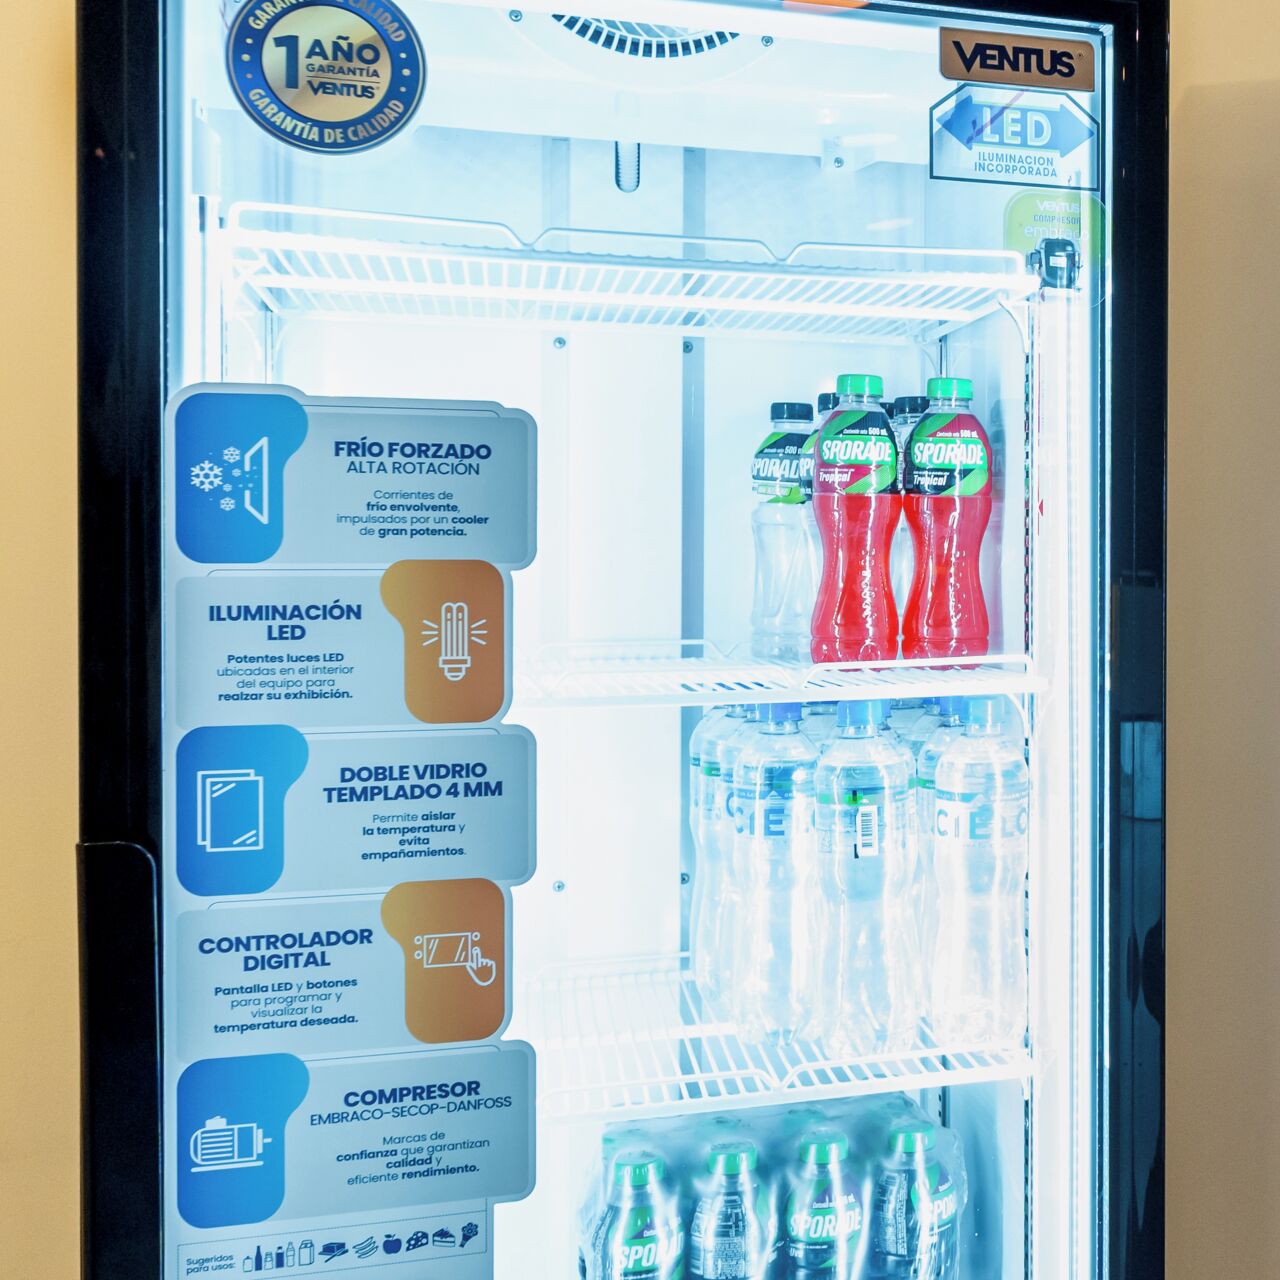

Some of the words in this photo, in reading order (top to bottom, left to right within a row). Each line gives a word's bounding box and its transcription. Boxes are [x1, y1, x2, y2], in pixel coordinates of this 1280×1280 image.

[273, 35, 299, 89] 1
[305, 35, 380, 65] AÑO
[952, 40, 1075, 78] VENTUS
[306, 63, 380, 78] GARANTÍA
[307, 80, 375, 99] VENTUS
[248, 88, 319, 142] GARANTÍA
[324, 128, 345, 143] DE
[347, 100, 404, 141] CALIDAD
[982, 106, 1051, 146] LED
[978, 151, 1054, 166] ILUMINACION
[974, 162, 1057, 177] INCORPORADA
[334, 436, 384, 457] FRÍO
[388, 441, 492, 460] FORZADO
[822, 440, 892, 461] SPORADE
[914, 442, 984, 465] SPORADE
[346, 460, 388, 474] ALTA
[392, 458, 480, 475] ROTACIÓN
[373, 489, 435, 500] Corrientes
[438, 490, 453, 500] de
[366, 501, 388, 512] frío
[390, 502, 461, 514] envolvente,
[336, 513, 408, 527] impulsados
[410, 515, 431, 527] por
[433, 516, 449, 525] un
[451, 514, 489, 525] cooler
[359, 525, 375, 536] de
[378, 527, 407, 539] gran
[410, 525, 467, 539] potencia.
[208, 599, 362, 621] ILUMINACIÓN
[266, 624, 306, 641] LED
[227, 653, 284, 665] Potentes
[286, 653, 320, 663] luces
[323, 652, 344, 663] LED
[217, 665, 276, 677] ubicadas
[279, 667, 295, 676] en
[298, 665, 310, 675] el
[312, 664, 354, 675] interior
[236, 677, 257, 688] del
[259, 677, 303, 691] equipo
[305, 678, 335, 691] para
[266, 691, 282, 701] su
[284, 689, 353, 700] exhibición.
[340, 766, 410, 784] DOBLE
[413, 762, 488, 781] VIDRIO
[323, 782, 442, 803] TEMPLADO
[446, 782, 461, 798] 4
[464, 781, 503, 797] MM
[372, 812, 419, 824] Permite
[421, 810, 456, 821] aislar
[362, 825, 374, 836] la
[376, 823, 456, 837] temperatura
[458, 824, 466, 834] y
[399, 835, 430, 846] evita
[361, 846, 466, 862] empañamientos.
[199, 928, 373, 954] CONTROLADOR
[243, 951, 331, 972] DIGITAL
[214, 984, 269, 996] Pantalla
[271, 982, 293, 993] LED
[296, 982, 303, 993] y
[306, 978, 358, 990] botones
[230, 997, 261, 1010] para
[264, 991, 332, 1007] programar
[334, 991, 342, 1003] y
[251, 1004, 309, 1019] visualizar
[311, 1004, 322, 1014] la
[214, 1018, 297, 1033] temperatura
[300, 1013, 359, 1027] deseada.
[343, 1080, 481, 1107] COMPRESOR
[310, 1095, 512, 1126] EMBRACO-SECOP-DANFOSS
[383, 1133, 427, 1146] Marcas
[429, 1131, 445, 1141] de
[336, 1148, 397, 1162] confianza
[400, 1146, 424, 1158] que
[426, 1138, 490, 1156] garantizan
[386, 1155, 432, 1169] calidad
[435, 1156, 443, 1167] y
[347, 1171, 399, 1186] eficiente
[401, 1164, 480, 1180] rendimiento.
[186, 1255, 234, 1267] Sugeridos
[187, 1266, 209, 1276] para
